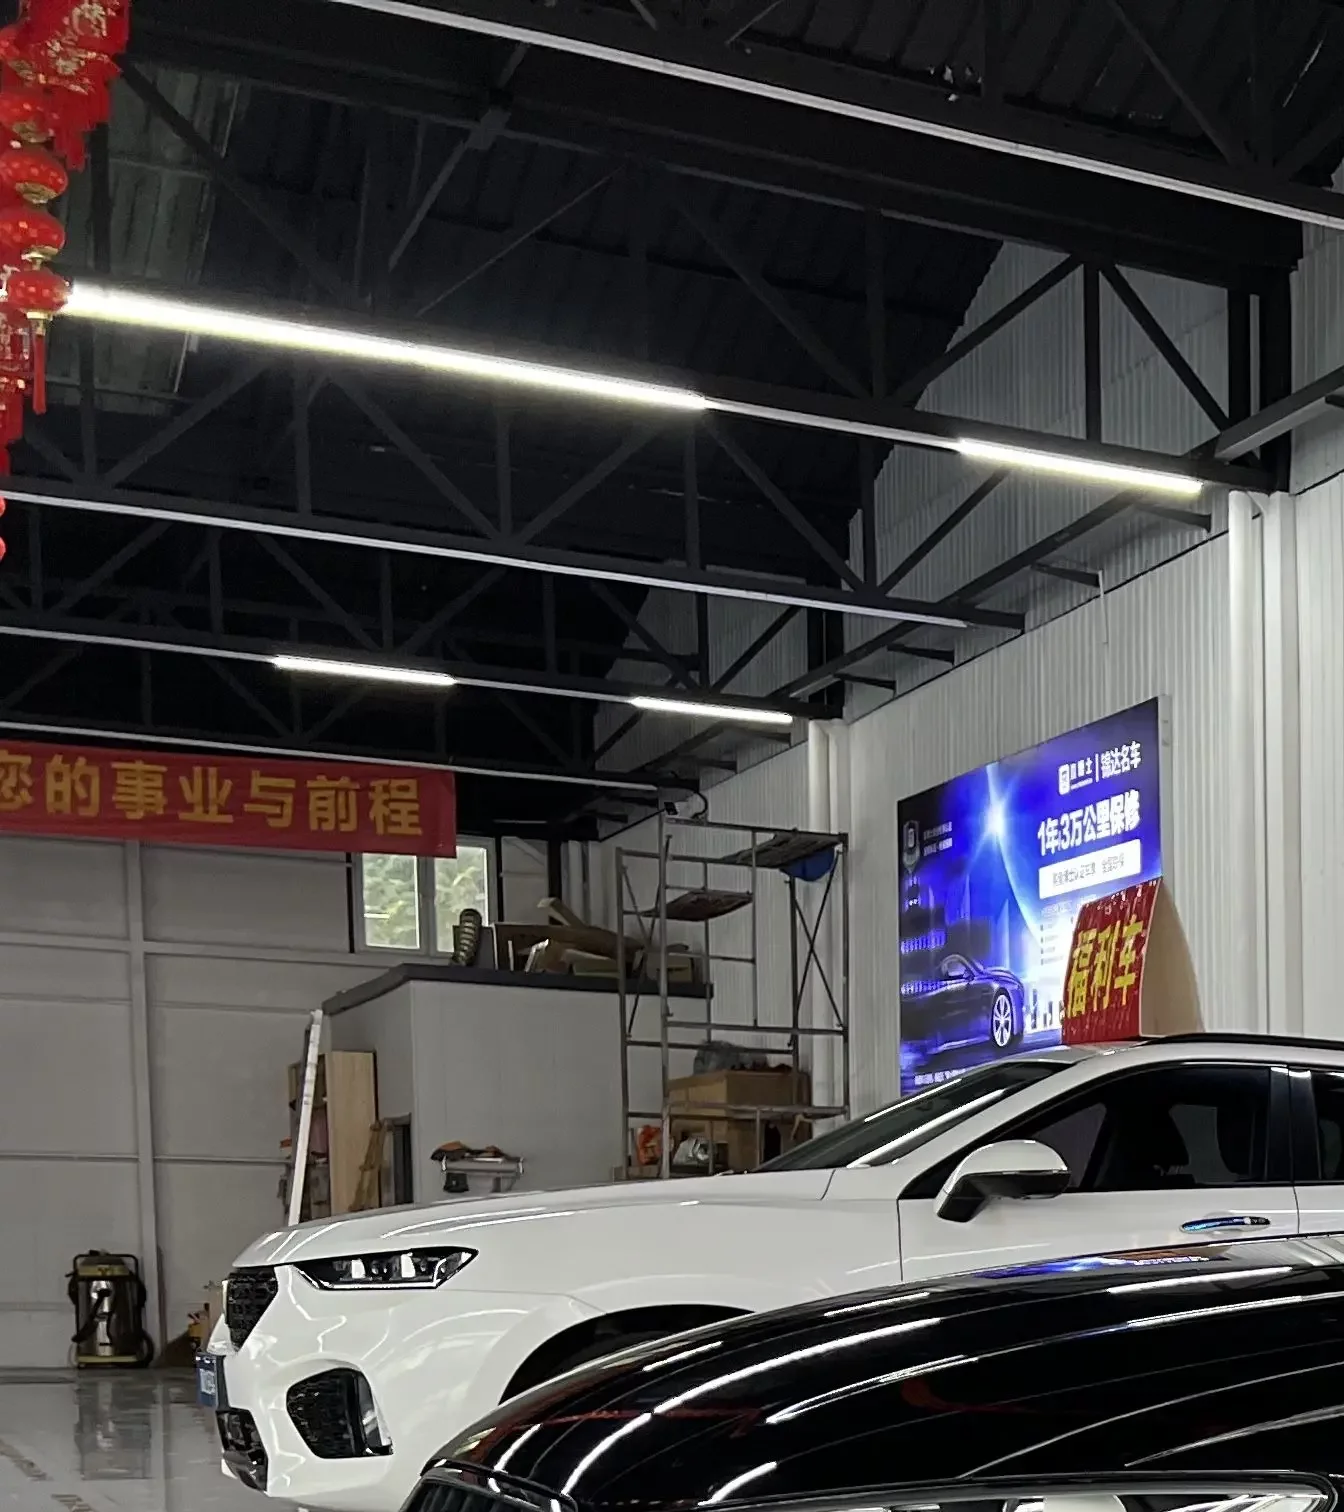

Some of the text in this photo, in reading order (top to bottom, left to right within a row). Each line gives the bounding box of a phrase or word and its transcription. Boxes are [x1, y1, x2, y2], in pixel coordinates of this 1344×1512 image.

[0, 749, 423, 836] 您的事业与前程
[1067, 914, 1144, 1018] 福利车
